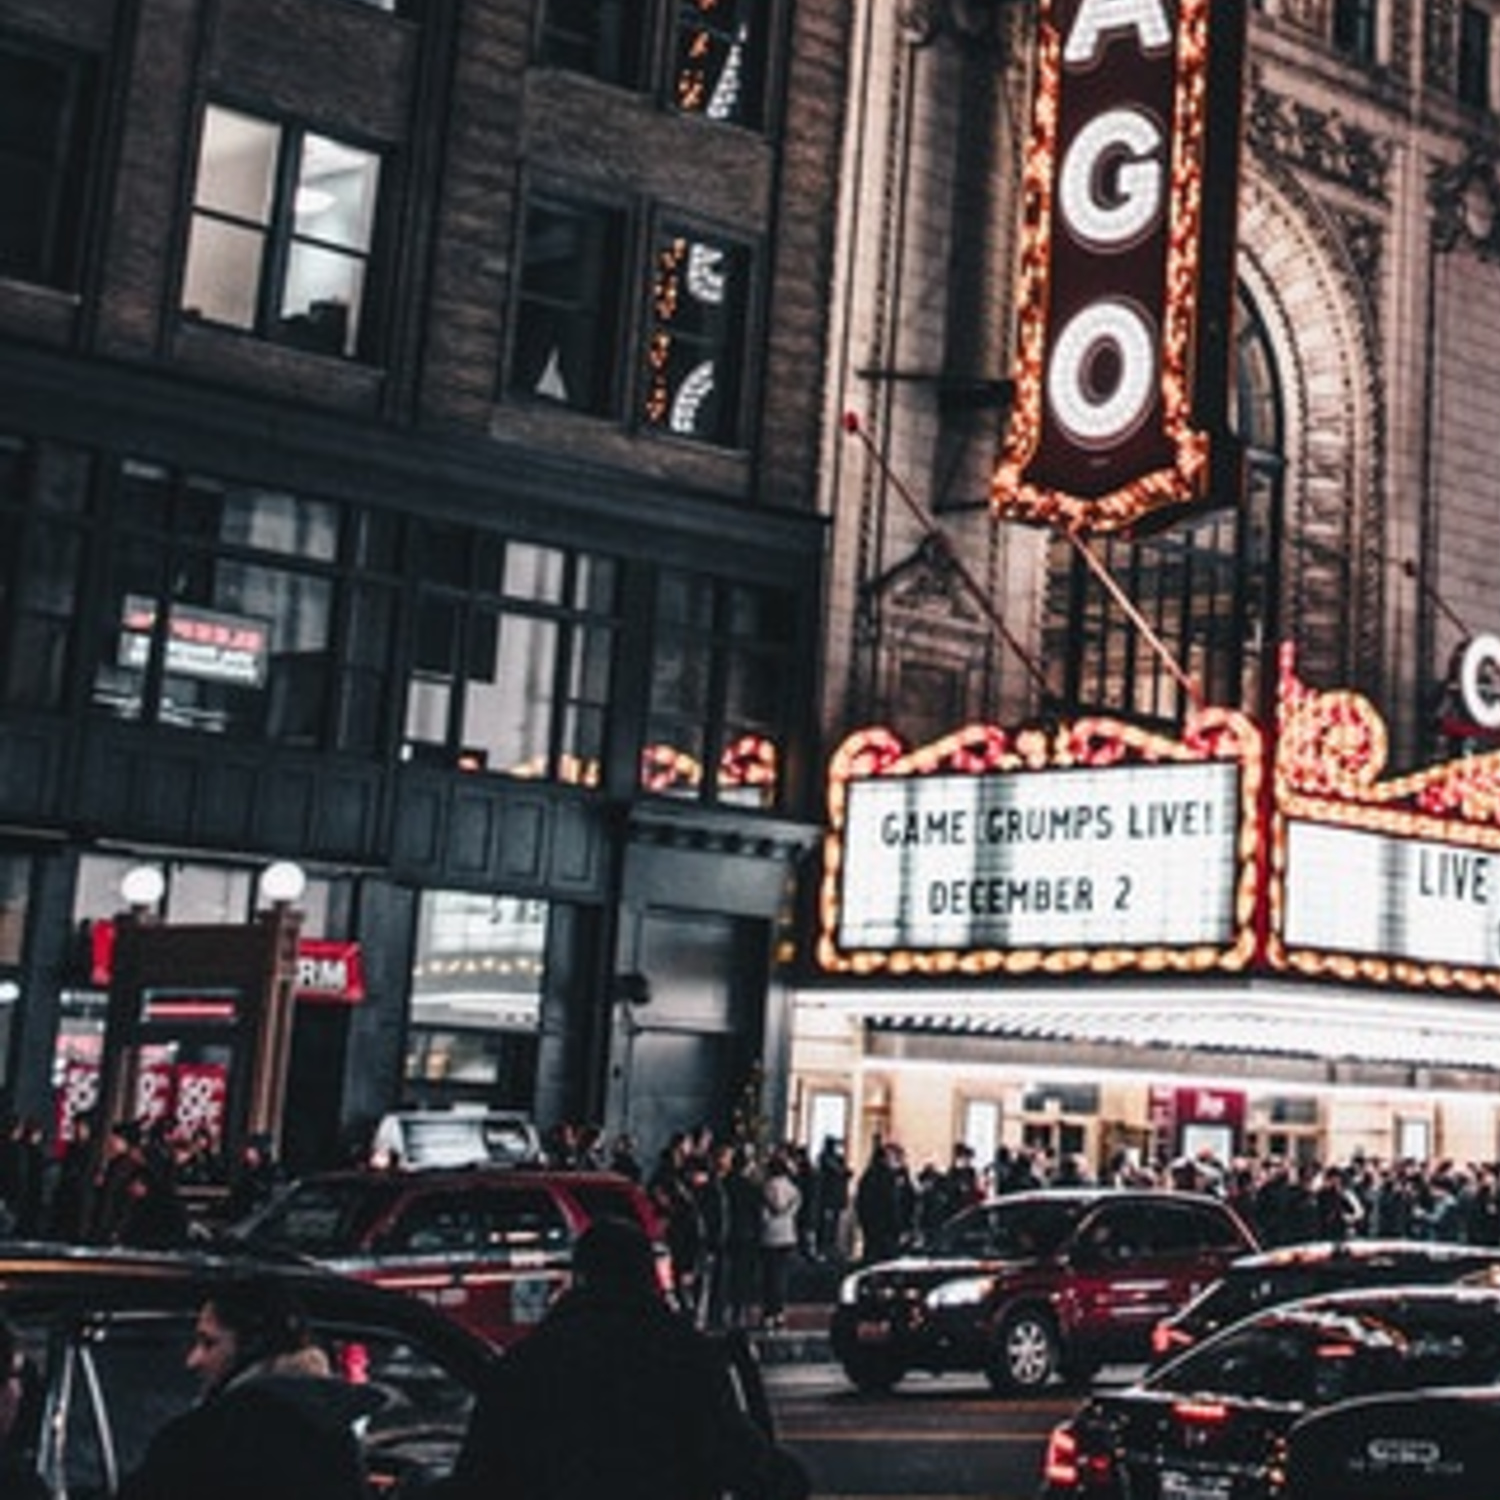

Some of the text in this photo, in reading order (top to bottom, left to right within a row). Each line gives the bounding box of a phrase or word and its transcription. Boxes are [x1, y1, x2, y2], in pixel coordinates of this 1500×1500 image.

[880, 800, 1213, 846] GAME GRUMPS LIVE!
[927, 875, 1132, 917] DECEMBER 2
[1417, 856, 1488, 904] LIVE
[297, 957, 348, 991] RM
